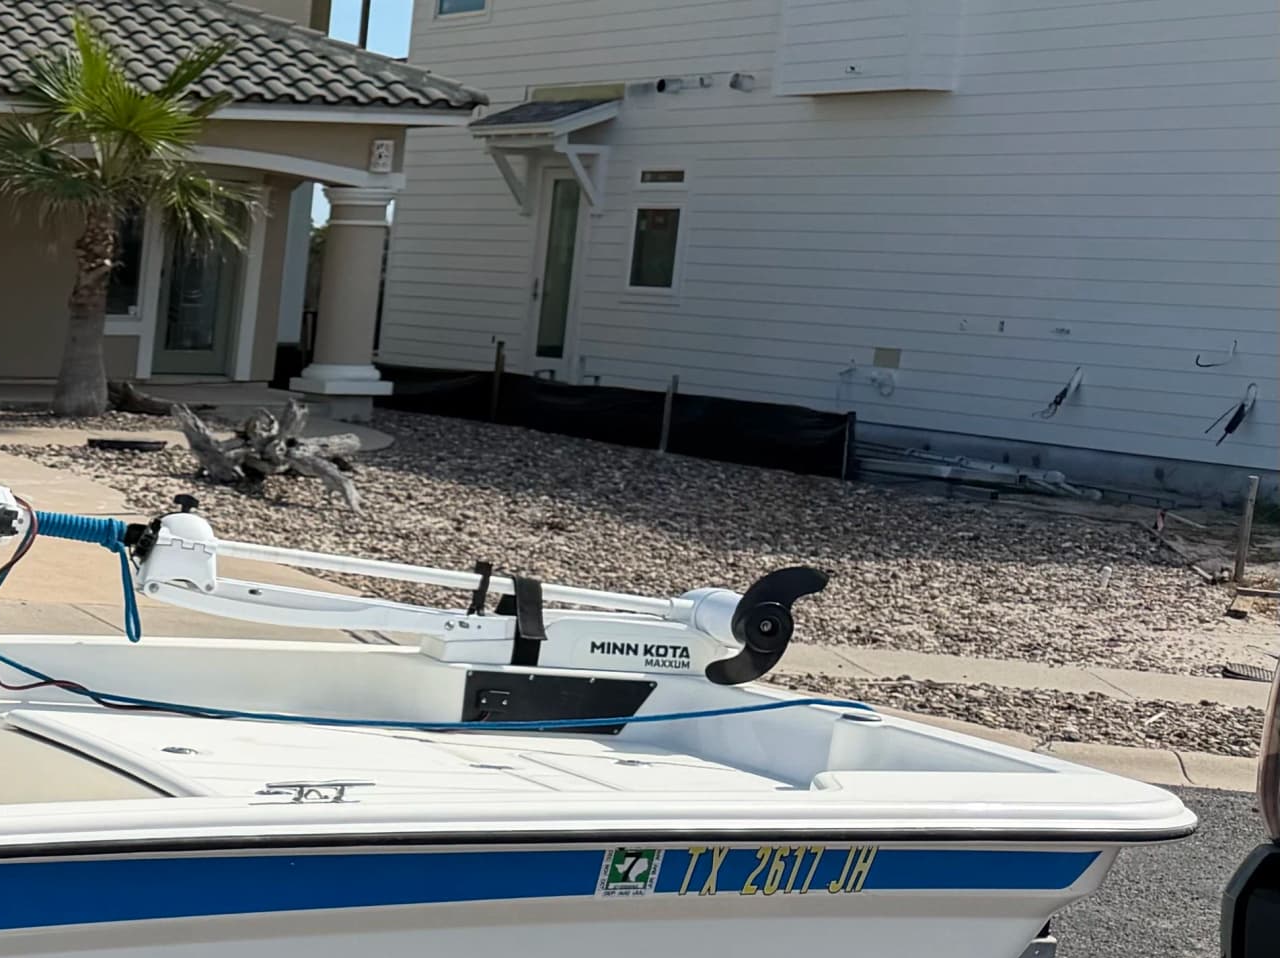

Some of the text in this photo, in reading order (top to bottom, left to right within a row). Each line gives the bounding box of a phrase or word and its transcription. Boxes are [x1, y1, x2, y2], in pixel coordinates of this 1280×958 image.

[590, 641, 690, 659] MINN KOTA
[644, 658, 690, 669] MAXXUM
[679, 845, 878, 895] TX 2617 JH
